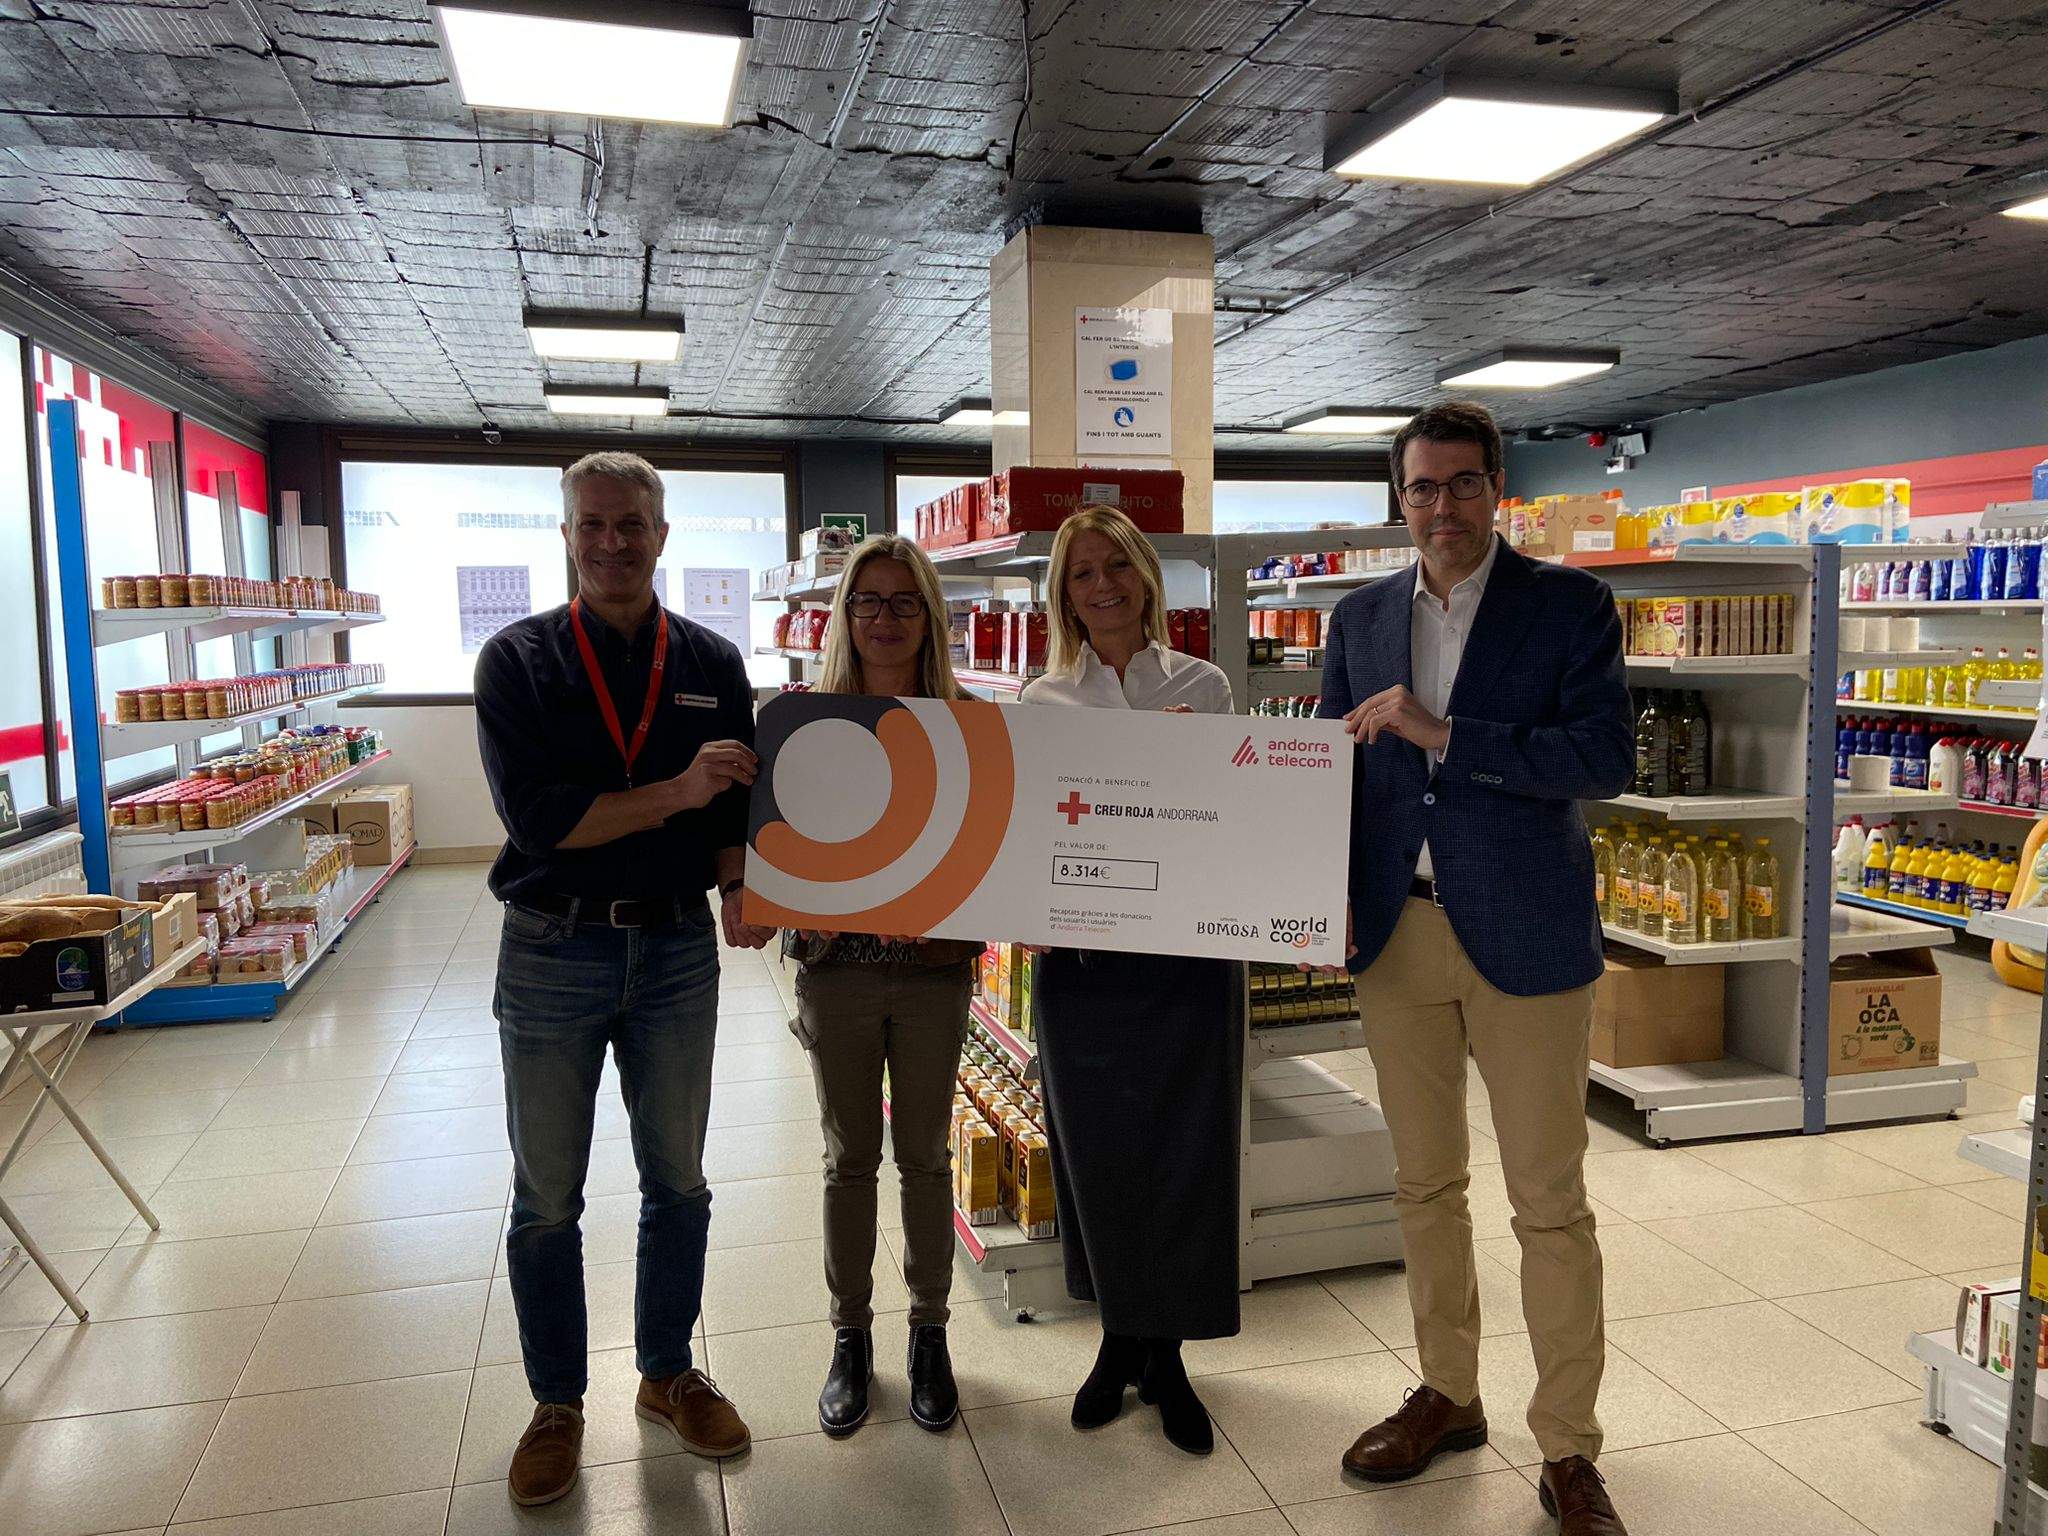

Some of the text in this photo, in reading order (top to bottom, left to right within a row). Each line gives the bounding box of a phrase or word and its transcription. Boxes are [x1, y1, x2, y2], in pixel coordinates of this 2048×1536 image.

[1267, 739, 1330, 753] andorra
[1267, 754, 1333, 769] telecom
[1058, 776, 1093, 785] DONACIÓ
[1104, 778, 1139, 787] BENEFICI
[1094, 804, 1219, 822] CREU ROJA ANDORRANA
[1069, 842, 1095, 850] VALOR
[1060, 863, 1112, 880] 8.314€
[1049, 907, 1080, 916] Recaptats
[1109, 911, 1119, 919] les
[1120, 912, 1152, 920] donacions
[1197, 921, 1259, 938] BOMOSA
[1270, 916, 1327, 933] world
[1867, 993, 1891, 1009] LA
[1859, 1007, 1900, 1024] OCA
